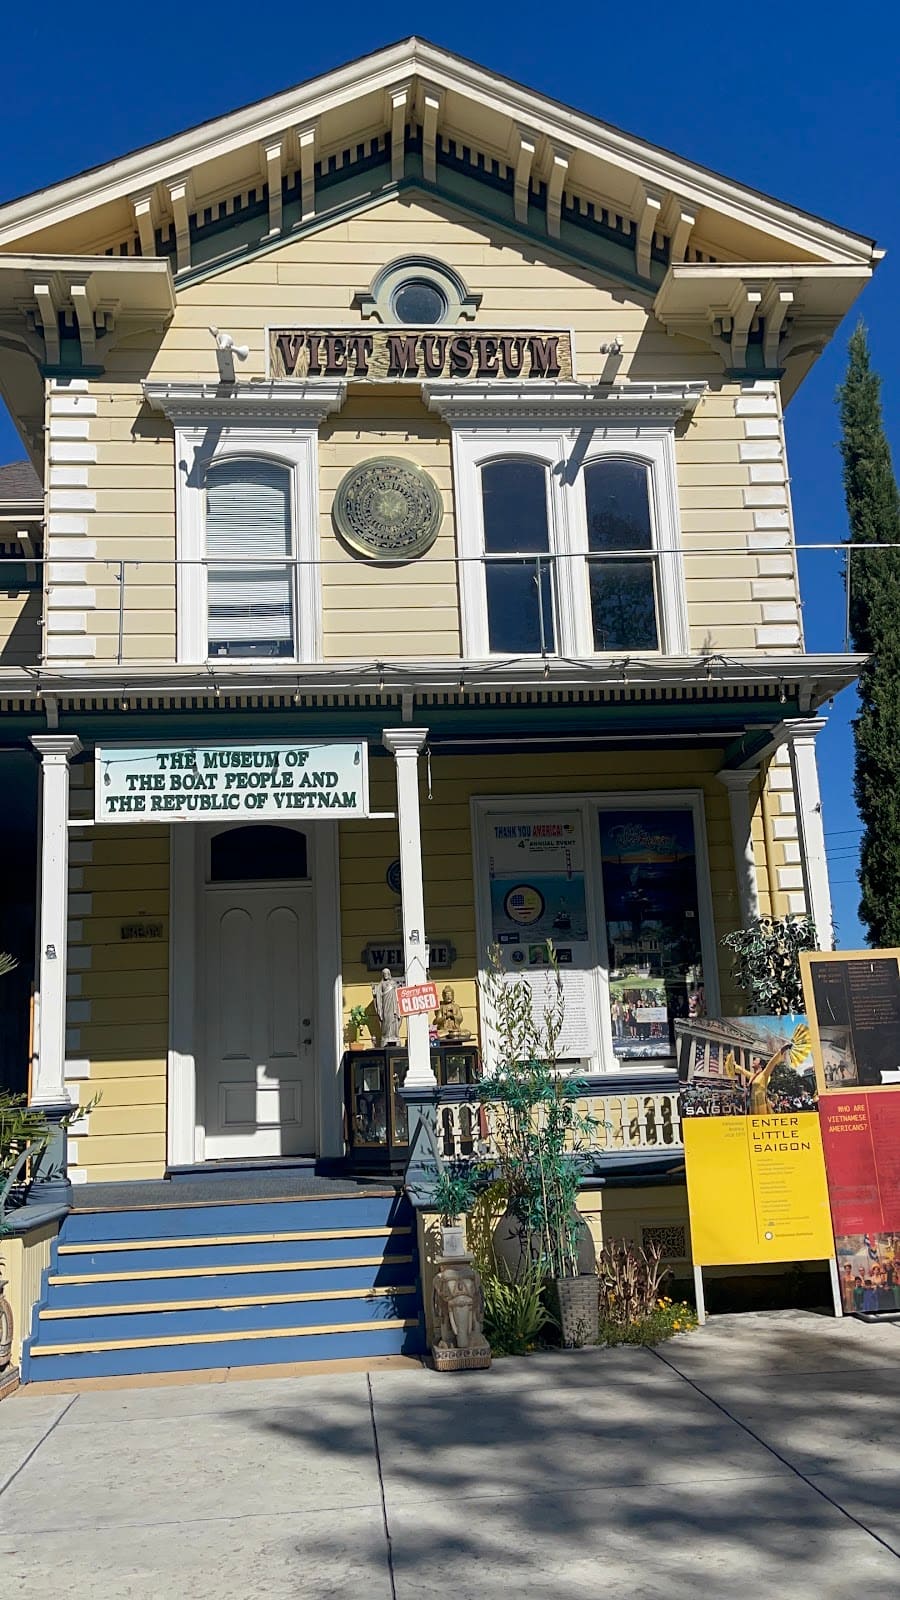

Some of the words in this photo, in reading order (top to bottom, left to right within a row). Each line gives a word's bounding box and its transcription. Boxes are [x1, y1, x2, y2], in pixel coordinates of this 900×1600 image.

[277, 335, 373, 376] VIET
[387, 335, 561, 377] MUSEUM
[157, 752, 196, 770] THE
[203, 751, 280, 769] MUSEUM
[285, 751, 309, 767] OF
[126, 774, 168, 791] THE
[170, 773, 217, 790] BOAT
[224, 772, 294, 789] PEOPLE
[299, 771, 338, 788] AND
[106, 795, 146, 812] THE
[151, 793, 240, 811] REPUBLIC
[244, 792, 268, 809] OF
[273, 791, 357, 809] VIETNAM
[494, 824, 517, 838] THANK
[518, 825, 531, 837] YOU
[402, 993, 436, 1012] CLOSED
[686, 1105, 744, 1116] SAIGON
[837, 1105, 850, 1113] WHO
[853, 1104, 865, 1112] ARE
[752, 1117, 799, 1128] ENTER
[827, 1113, 867, 1123] VIETNAMESE
[829, 1123, 868, 1133] AMERICANS?
[753, 1130, 799, 1141] LITTLE
[754, 1142, 811, 1153] SAIGON
